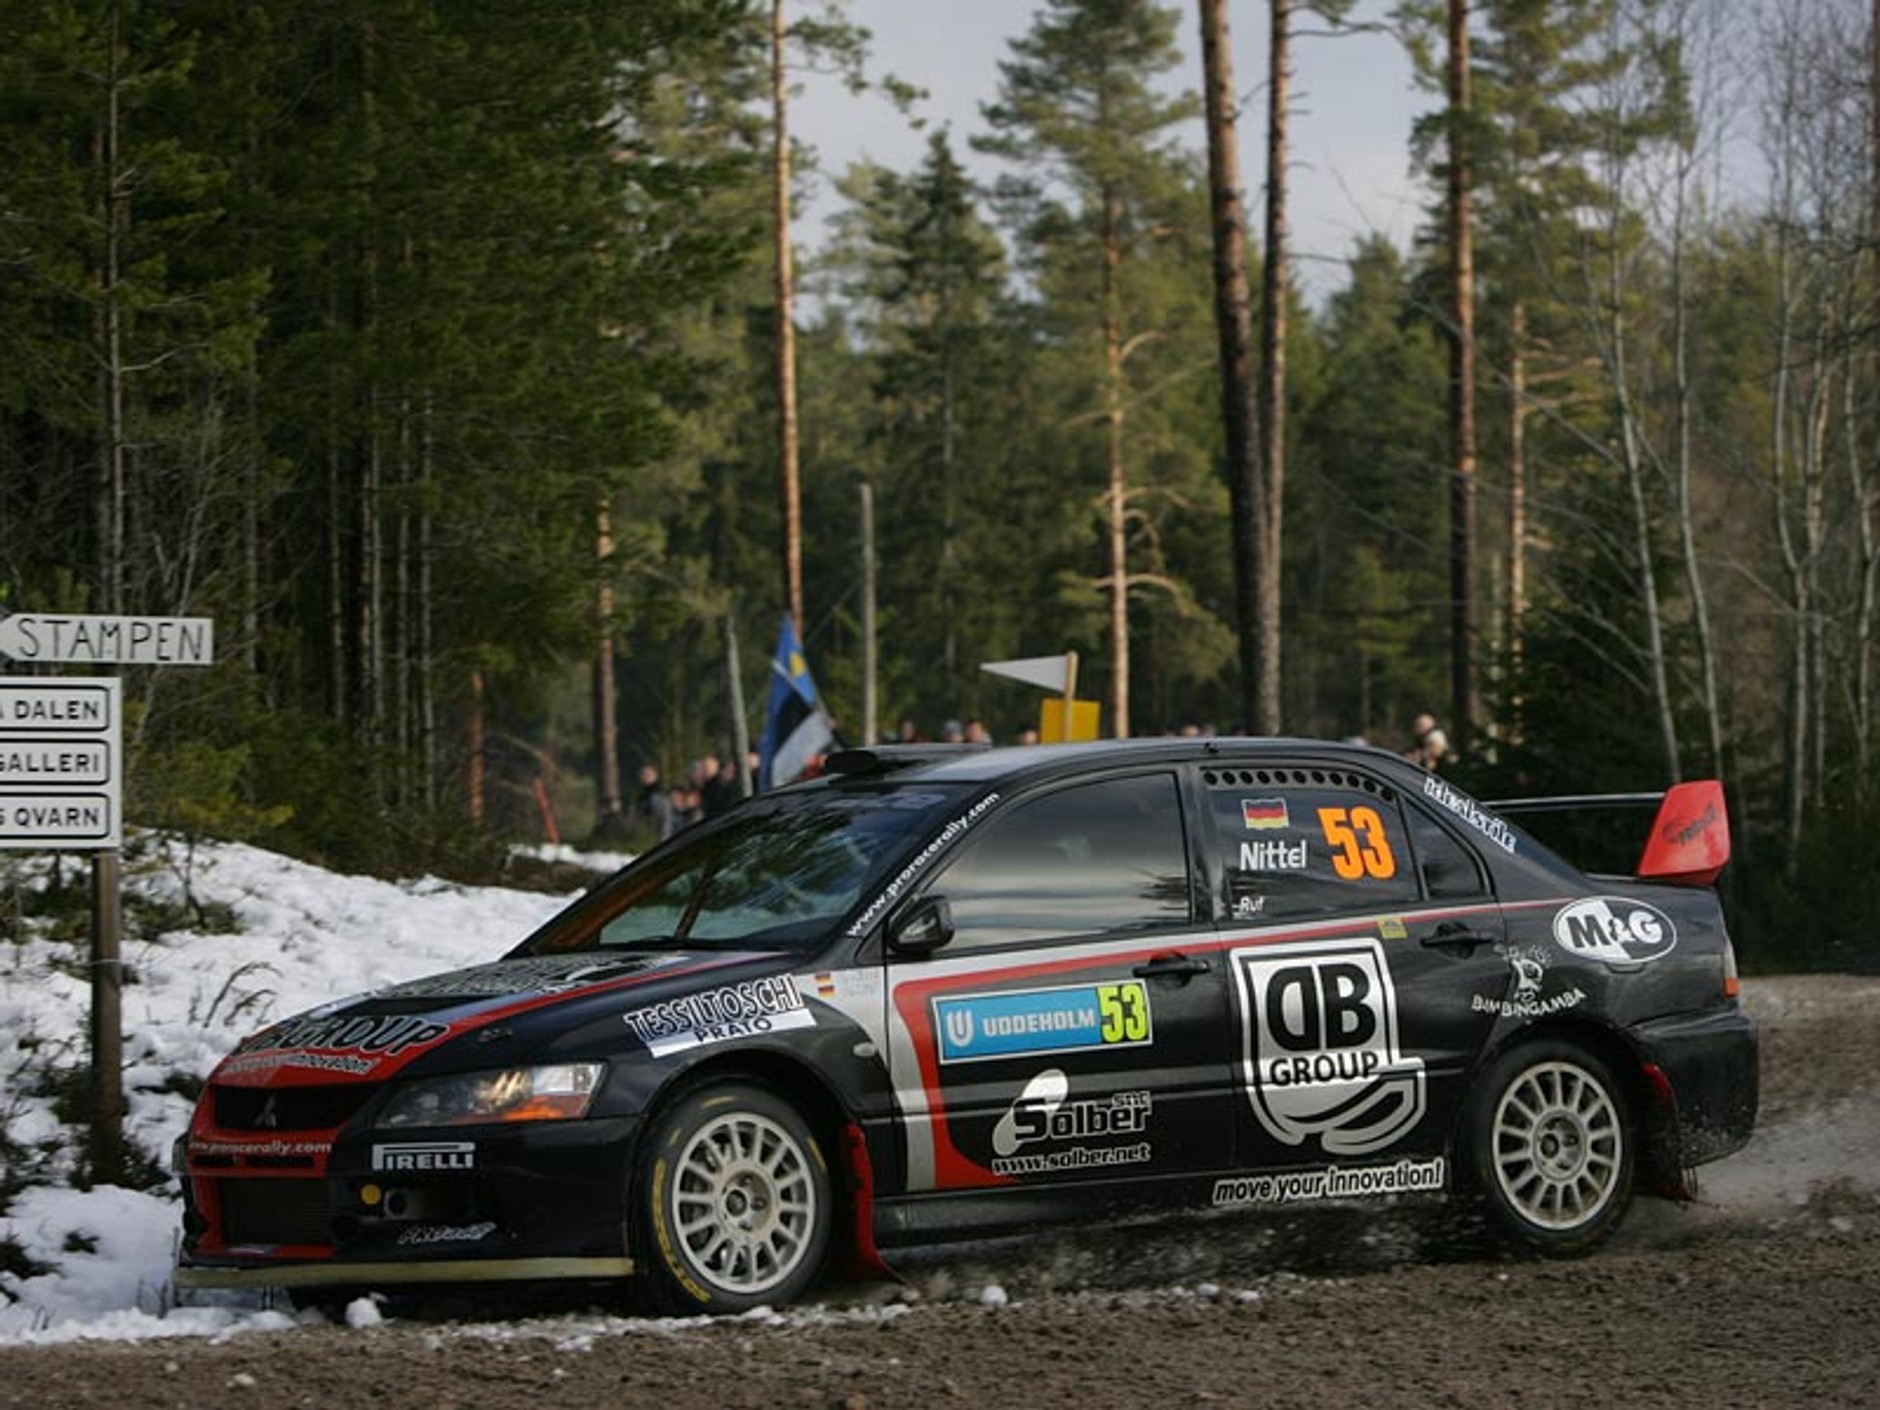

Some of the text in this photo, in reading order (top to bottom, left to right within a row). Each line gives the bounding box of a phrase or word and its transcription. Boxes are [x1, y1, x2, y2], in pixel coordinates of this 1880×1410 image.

[17, 617, 204, 661] STAMPEN
[14, 700, 99, 720] DALEN
[14, 807, 99, 827] QVARN
[1239, 840, 1307, 871] Nittel
[1316, 805, 1399, 881] 53
[846, 792, 1000, 937] www.proracerally.com
[1566, 909, 1664, 949] M&G
[694, 1017, 773, 1042] PRATO
[981, 1008, 1097, 1038] UDDEHOLM
[1098, 982, 1149, 1043] 53
[1268, 1051, 1379, 1087] GROUP
[1012, 1097, 1151, 1144] Solber
[371, 1141, 476, 1171] PIRELLI
[992, 1142, 1151, 1176] www.solber.net
[1214, 1158, 1444, 1204] move your innovation!
